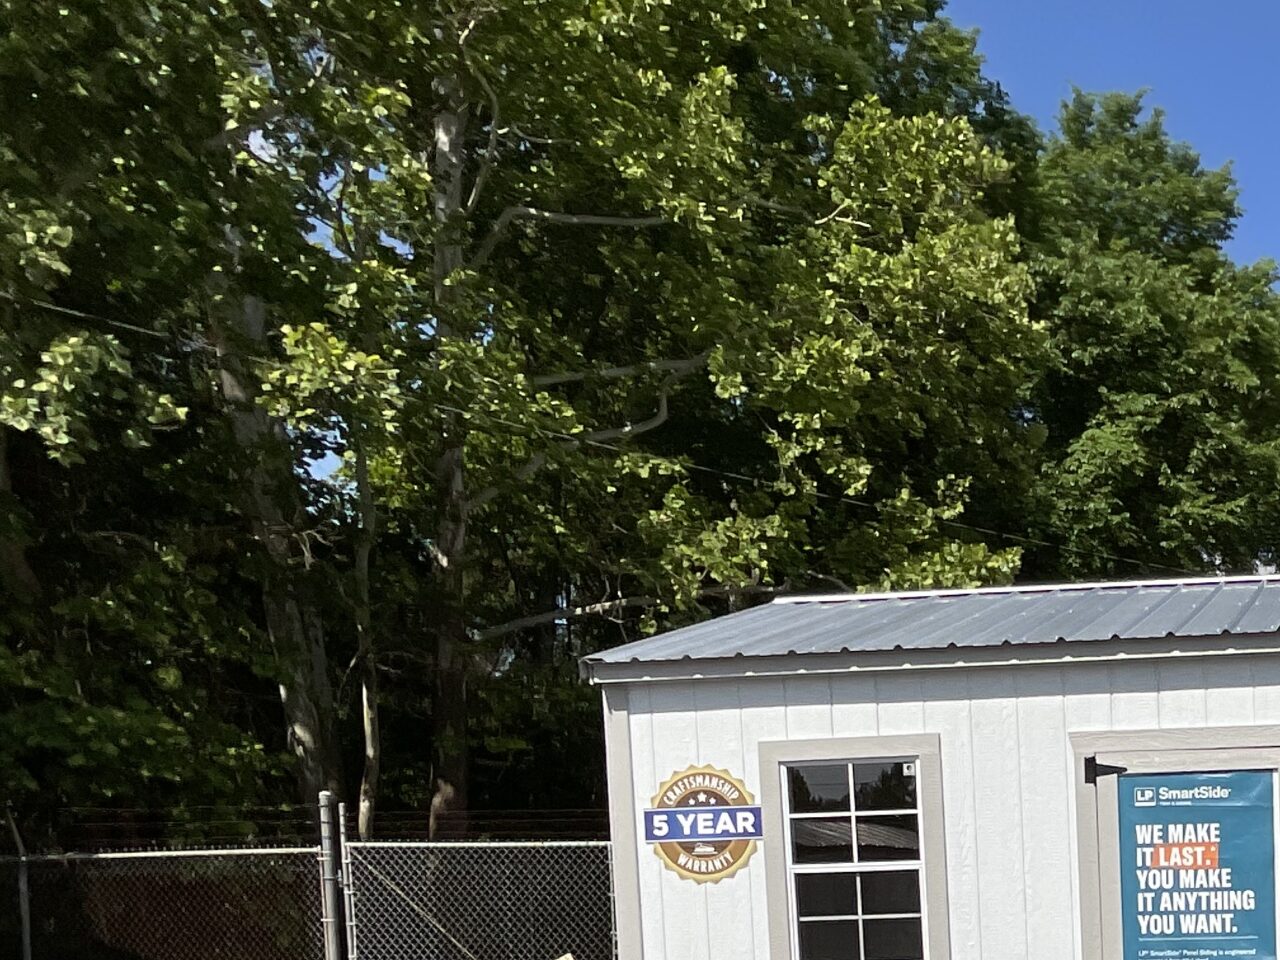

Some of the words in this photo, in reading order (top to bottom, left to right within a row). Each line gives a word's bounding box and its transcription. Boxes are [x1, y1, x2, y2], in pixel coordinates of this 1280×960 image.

[663, 774, 739, 805] CRAFTSMANSHIP
[1136, 790, 1153, 801] LP
[652, 814, 669, 837] 5
[676, 811, 756, 836] YEAR
[1135, 824, 1163, 844] WE
[1168, 823, 1220, 843] MAKE
[677, 851, 734, 873] WARRANTY
[1136, 847, 1154, 867] IT
[1136, 869, 1174, 889] YOU
[1179, 868, 1232, 888] MAKE
[1137, 892, 1155, 912] IT
[1160, 890, 1256, 911] ANYTHING
[1137, 914, 1175, 934] YOU
[1179, 913, 1238, 933] WANT.
